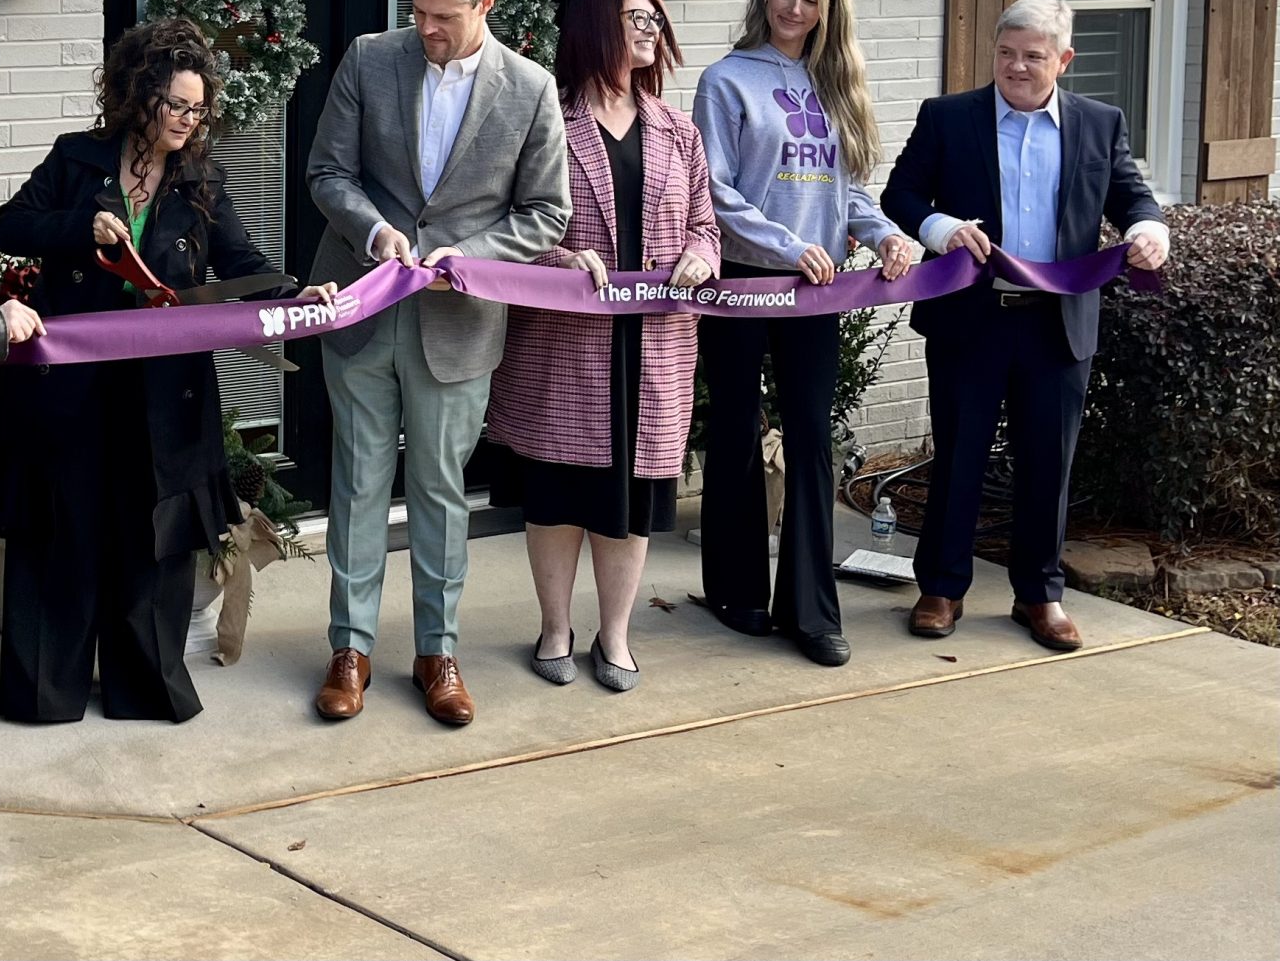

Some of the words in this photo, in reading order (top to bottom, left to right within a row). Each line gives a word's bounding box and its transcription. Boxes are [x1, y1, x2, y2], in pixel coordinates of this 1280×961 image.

[781, 141, 836, 168] PRN
[599, 283, 631, 302] The
[635, 282, 694, 301] Retreat
[287, 302, 337, 330] PRN
